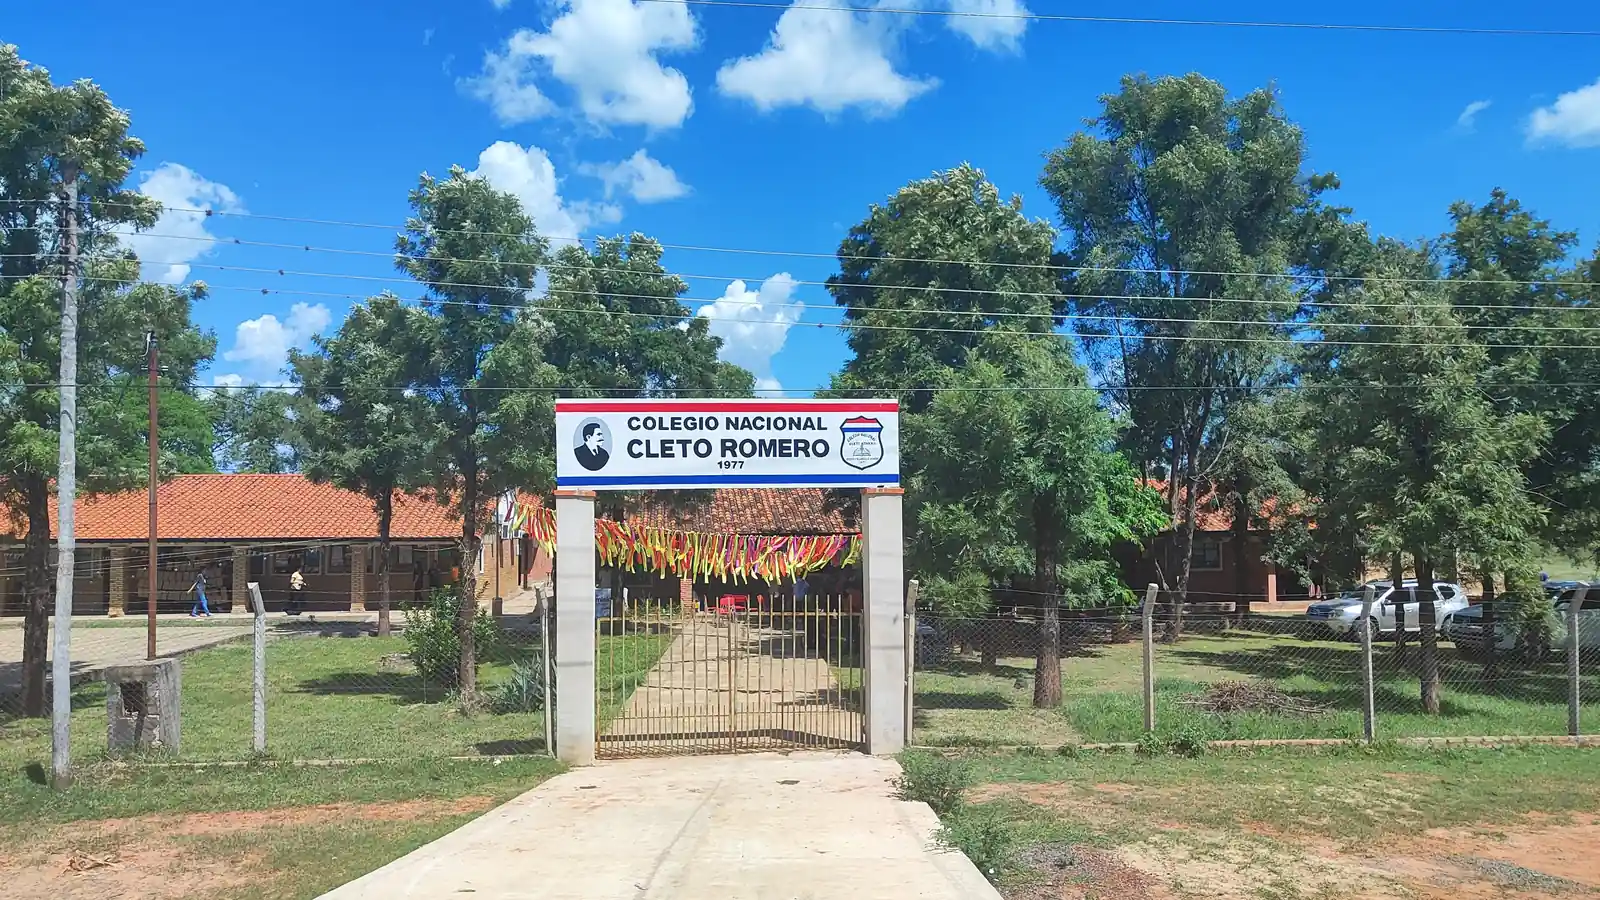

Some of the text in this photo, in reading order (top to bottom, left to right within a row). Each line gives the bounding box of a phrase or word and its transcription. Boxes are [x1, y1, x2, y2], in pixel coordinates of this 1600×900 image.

[627, 415, 828, 431] COLEGIO NACIONAL
[626, 438, 830, 459] CLETO ROMERO
[717, 460, 745, 470] 1977
